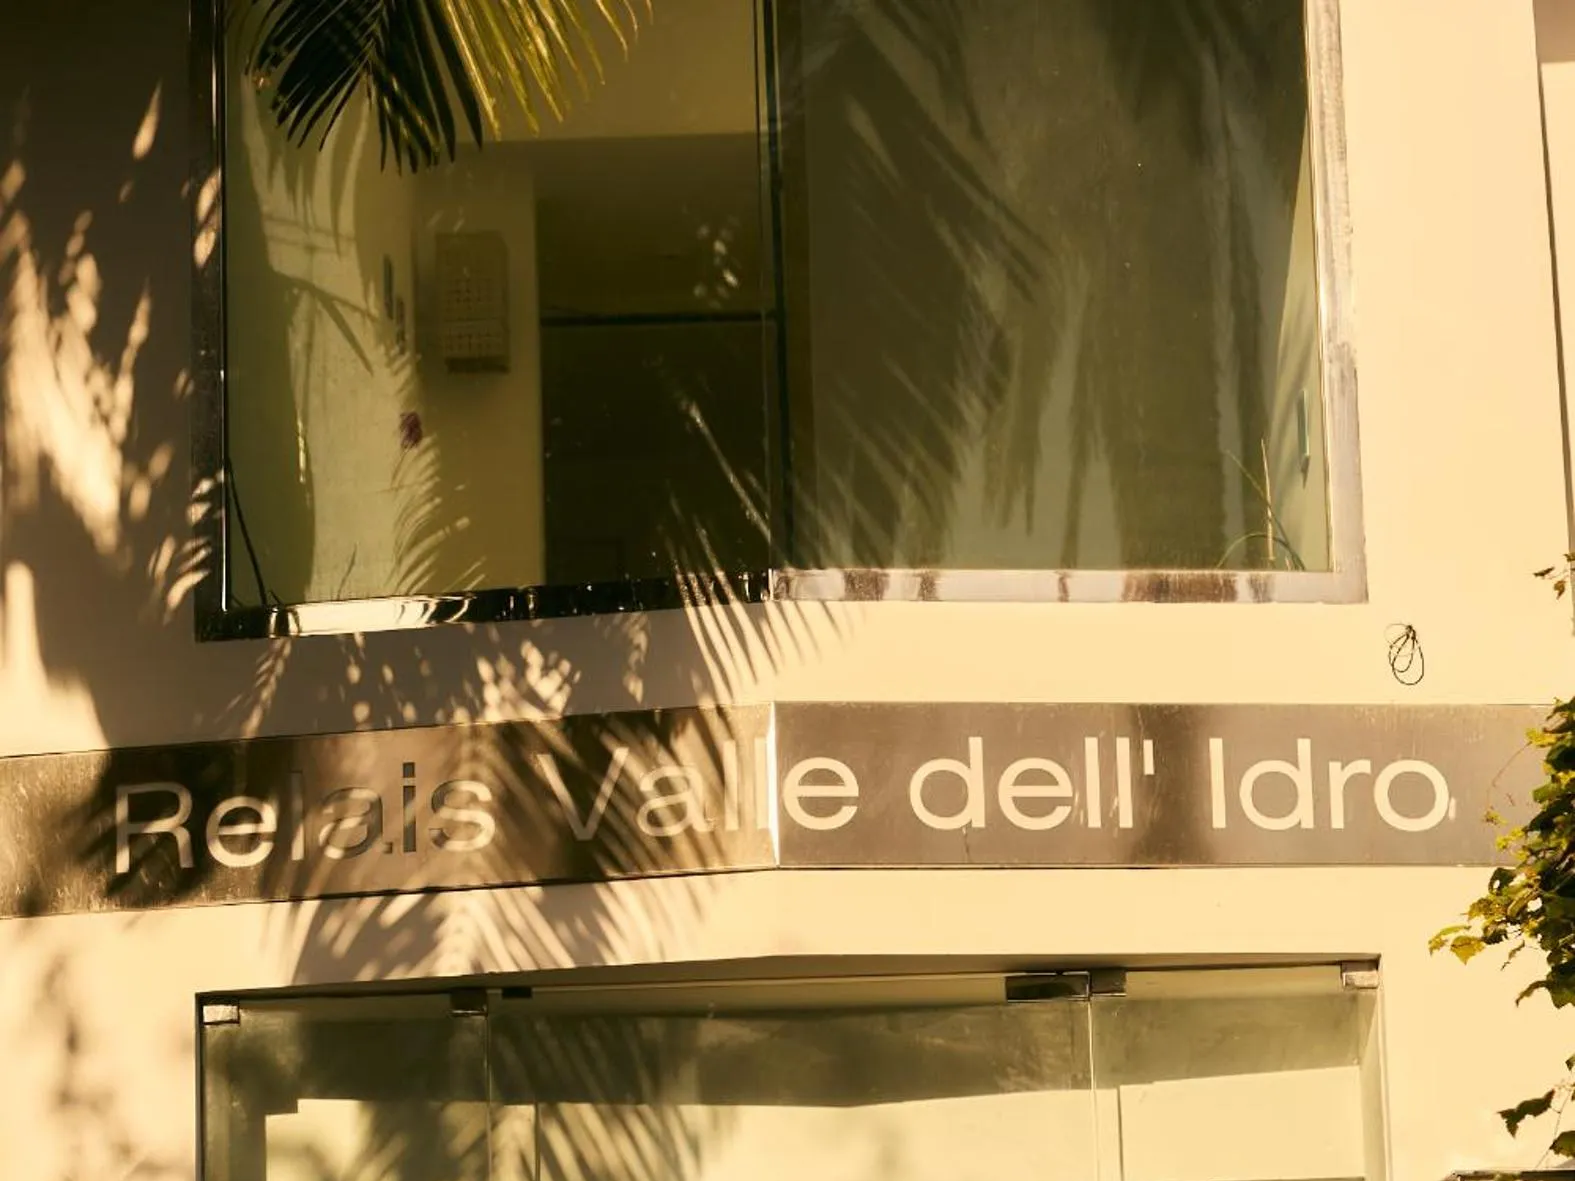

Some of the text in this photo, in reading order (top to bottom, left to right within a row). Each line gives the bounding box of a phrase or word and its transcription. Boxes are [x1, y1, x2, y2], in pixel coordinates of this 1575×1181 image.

[115, 736, 1451, 874] Relais Valle dell' Idro
